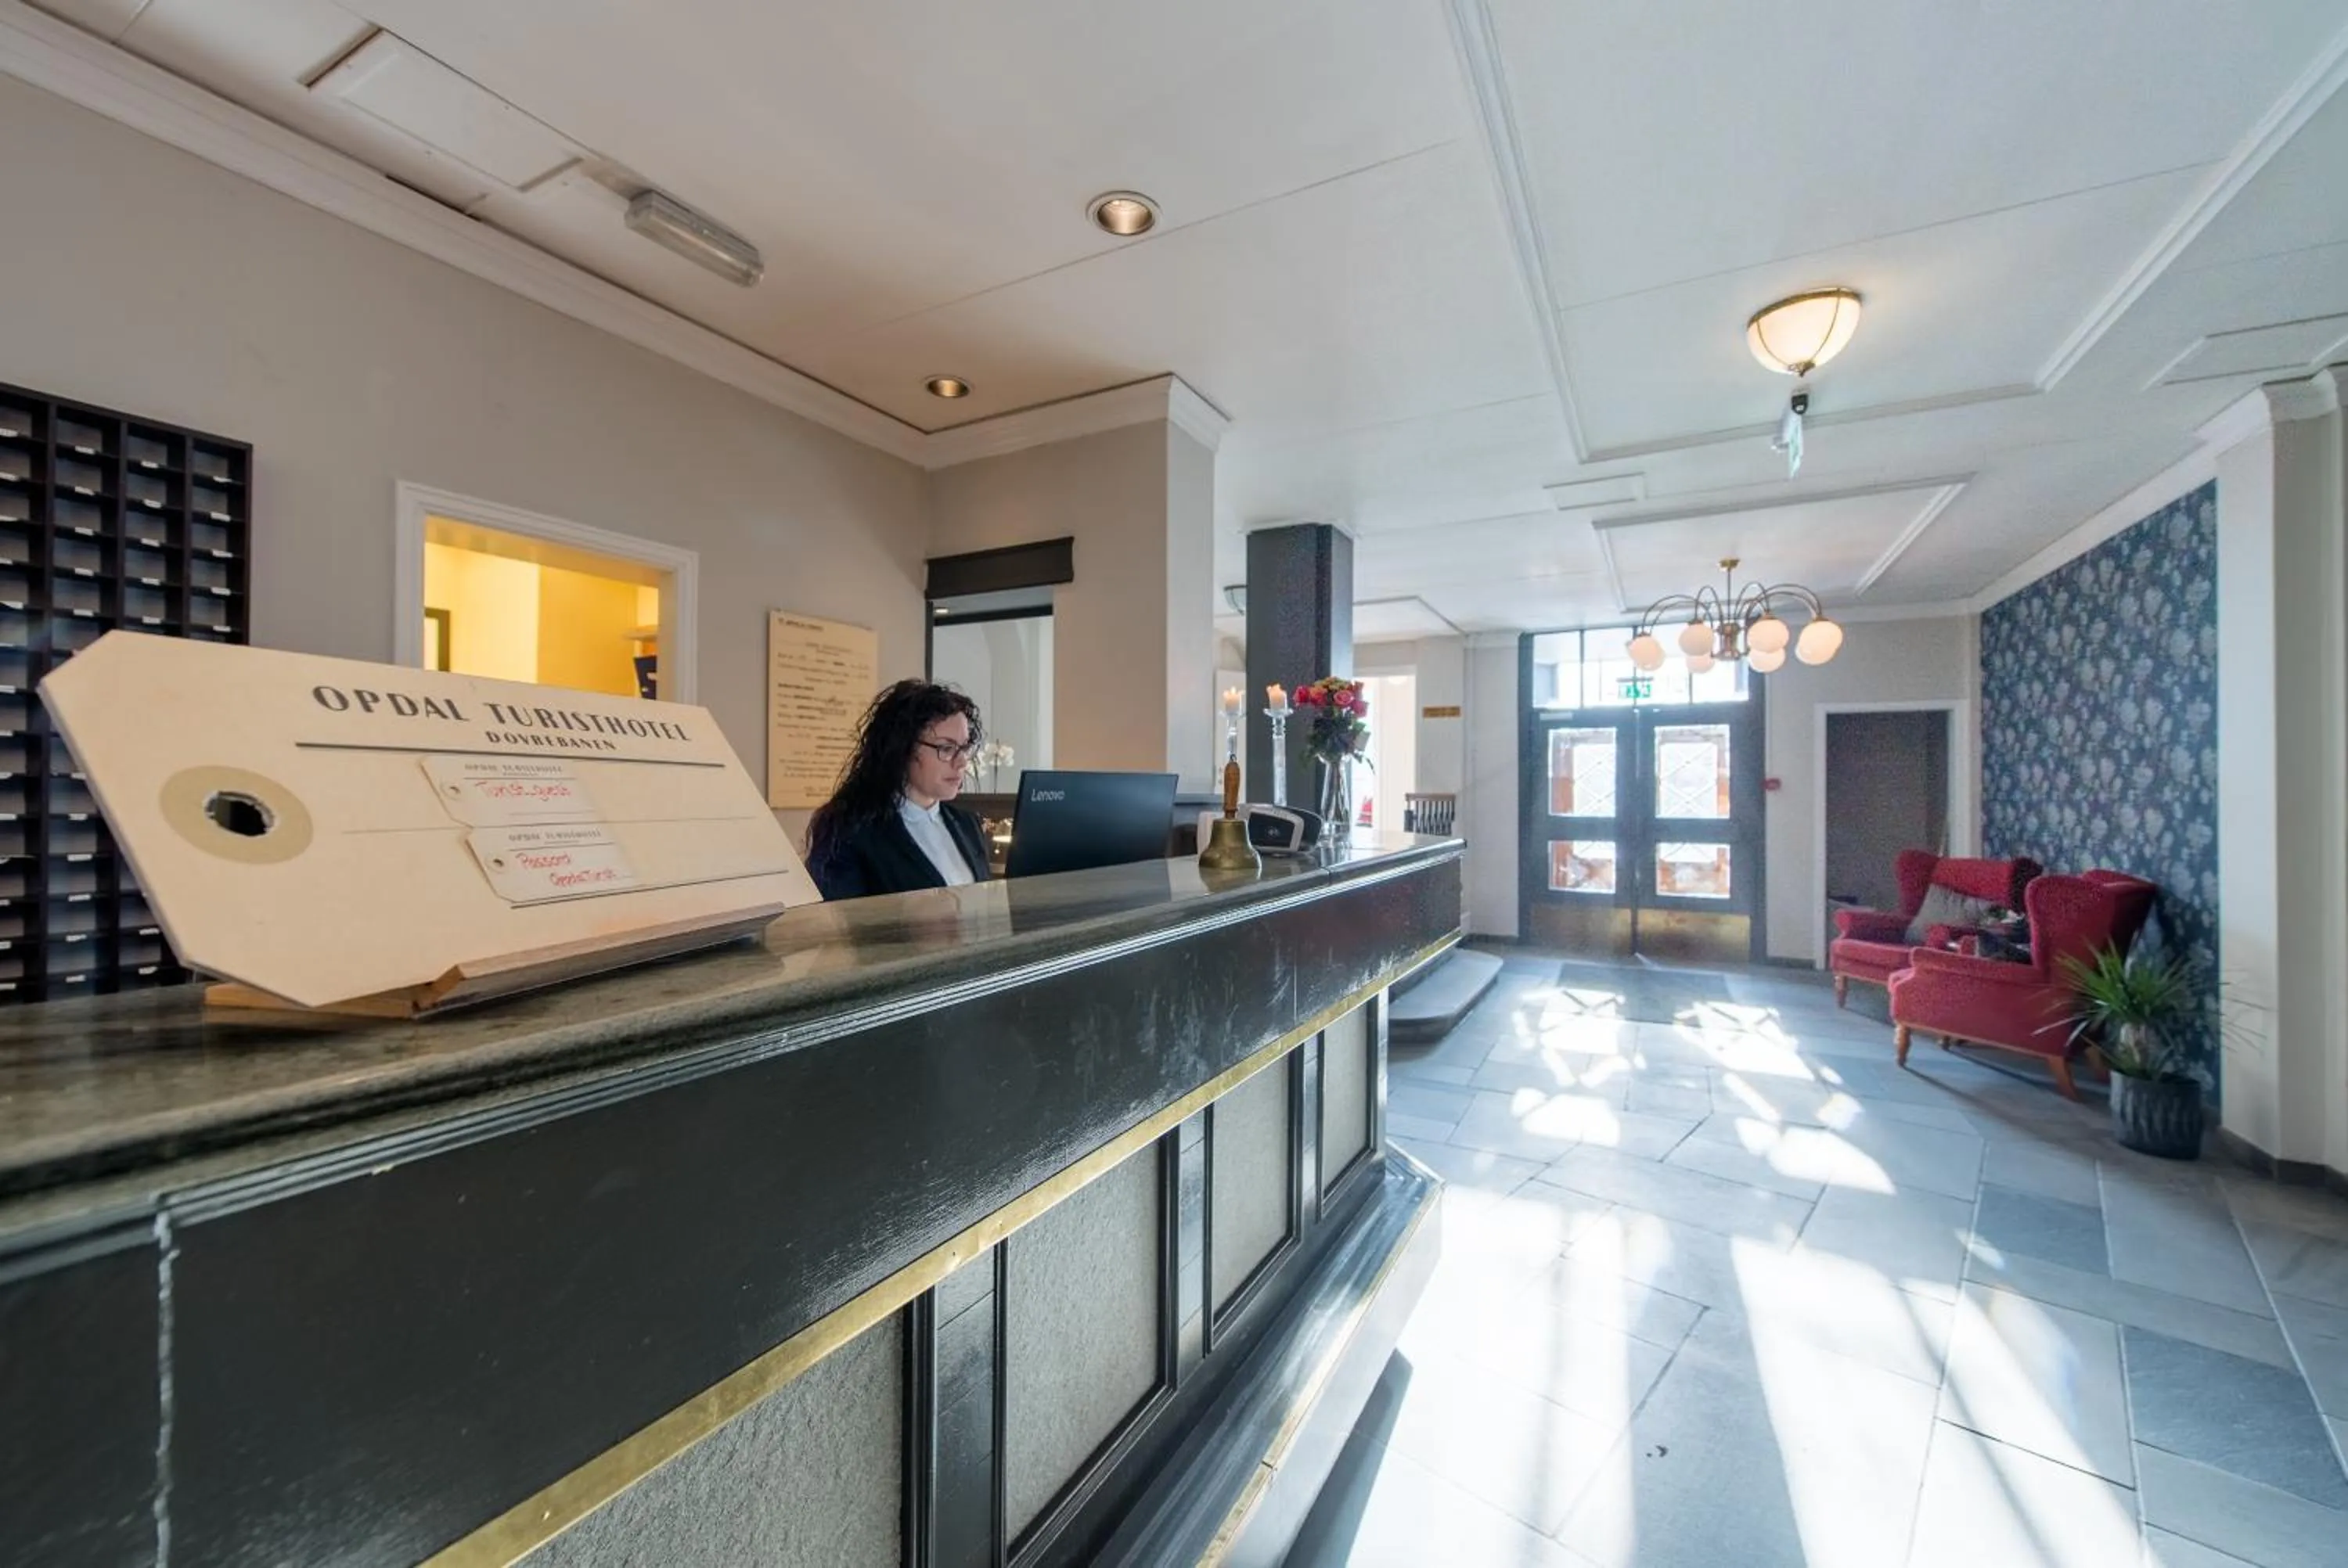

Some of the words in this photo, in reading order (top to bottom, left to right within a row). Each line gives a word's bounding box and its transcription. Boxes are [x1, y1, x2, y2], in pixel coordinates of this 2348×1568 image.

[312, 685, 470, 721] OPDAL
[483, 702, 693, 742] TURISTHOTEL
[485, 731, 617, 750] DOVREBANEN
[1031, 788, 1065, 802] Lenovo
